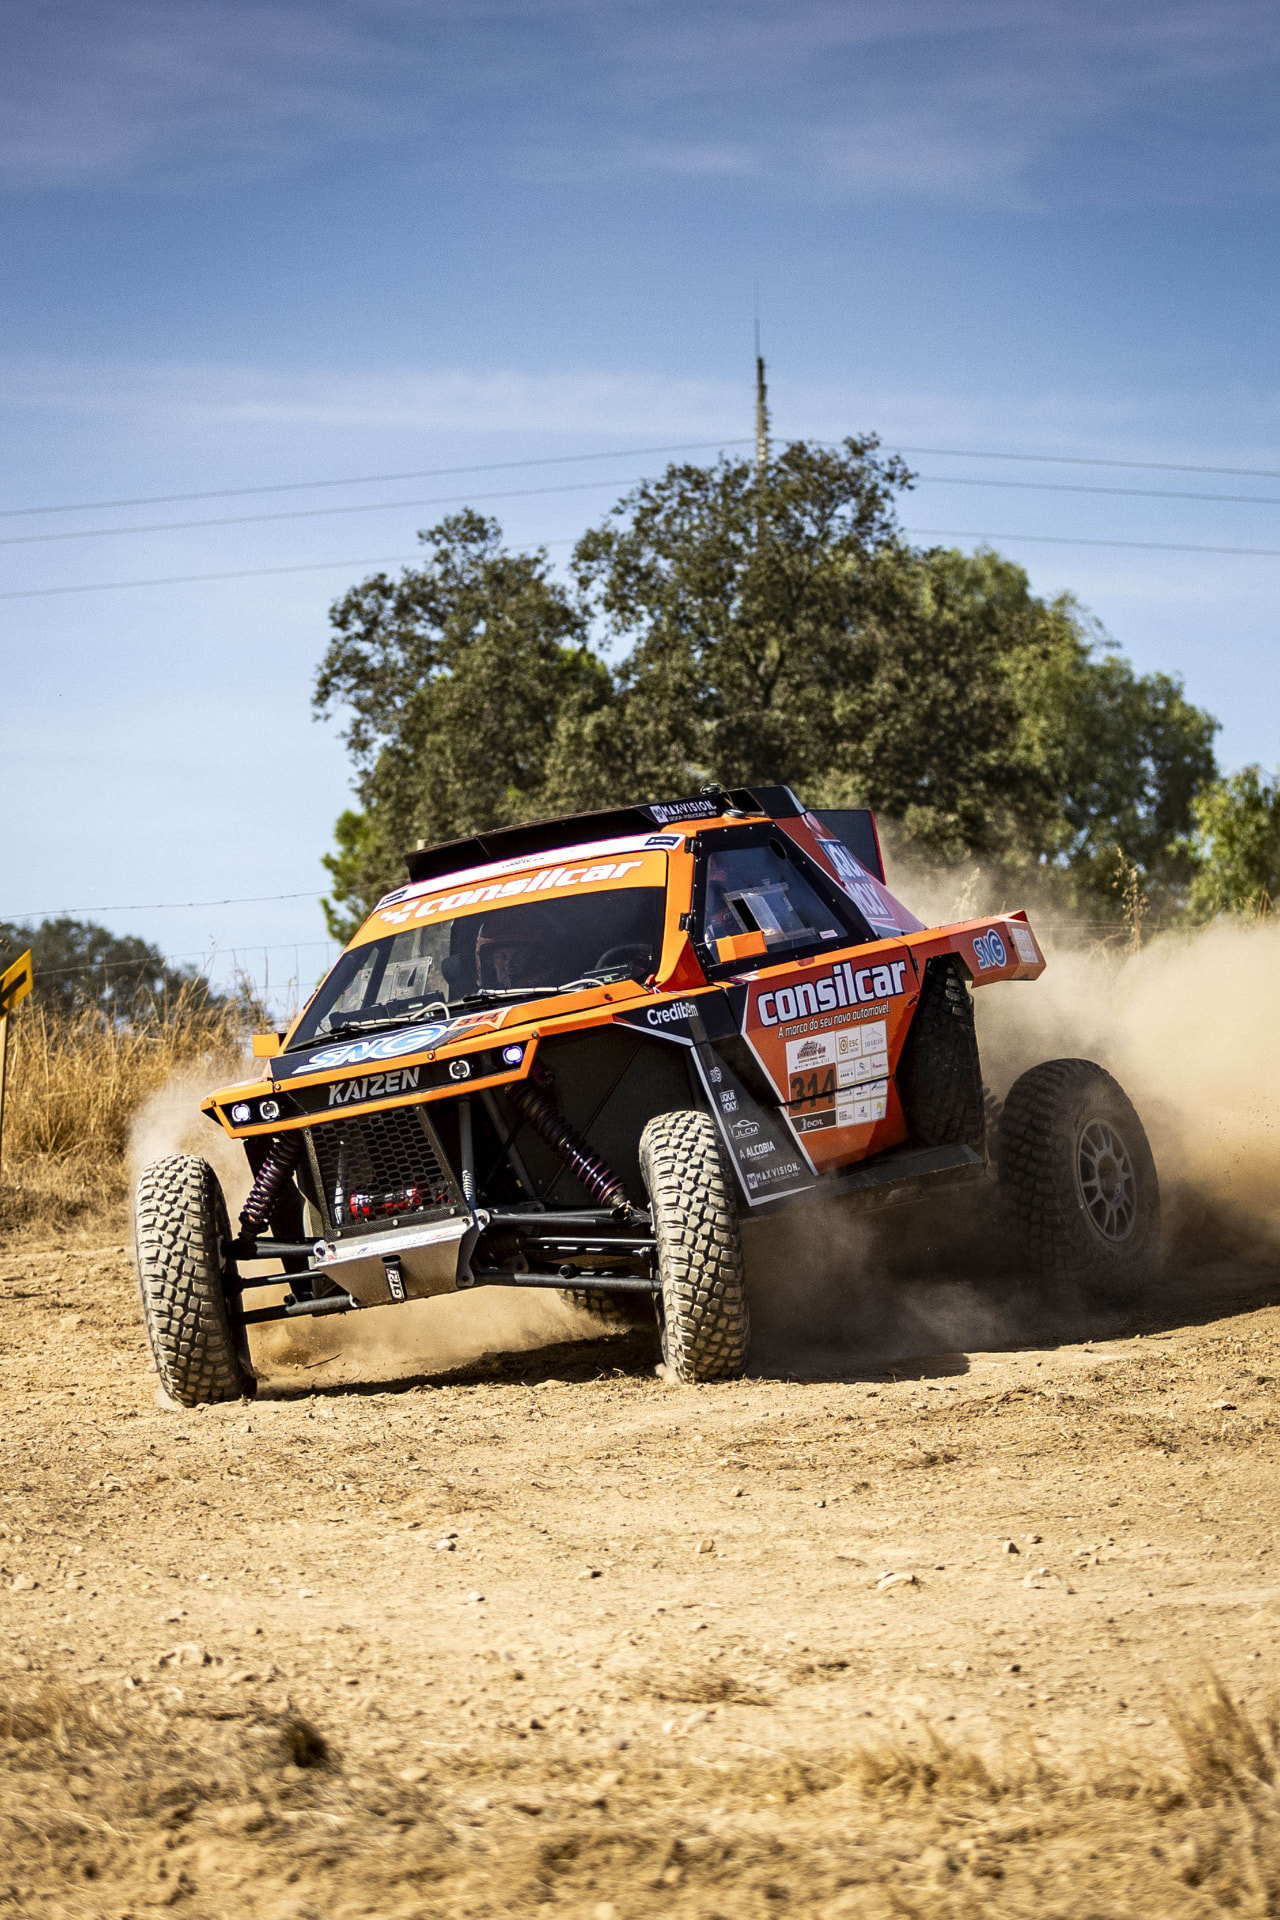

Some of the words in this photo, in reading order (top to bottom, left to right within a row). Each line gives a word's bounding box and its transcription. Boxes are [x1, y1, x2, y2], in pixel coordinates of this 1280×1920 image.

[414, 860, 644, 918] consilcar
[973, 929, 1006, 969] SNG
[757, 960, 907, 1027] consilcar
[777, 1025, 784, 1039] A
[785, 1022, 808, 1037] marca
[809, 1018, 819, 1031] do
[820, 1017, 833, 1029] seu
[834, 1013, 851, 1026] novo
[292, 1024, 449, 1074] SNG
[328, 1067, 420, 1106] KAIZEN
[791, 1068, 835, 1111] 314
[746, 1140, 776, 1157] ALCOBIA
